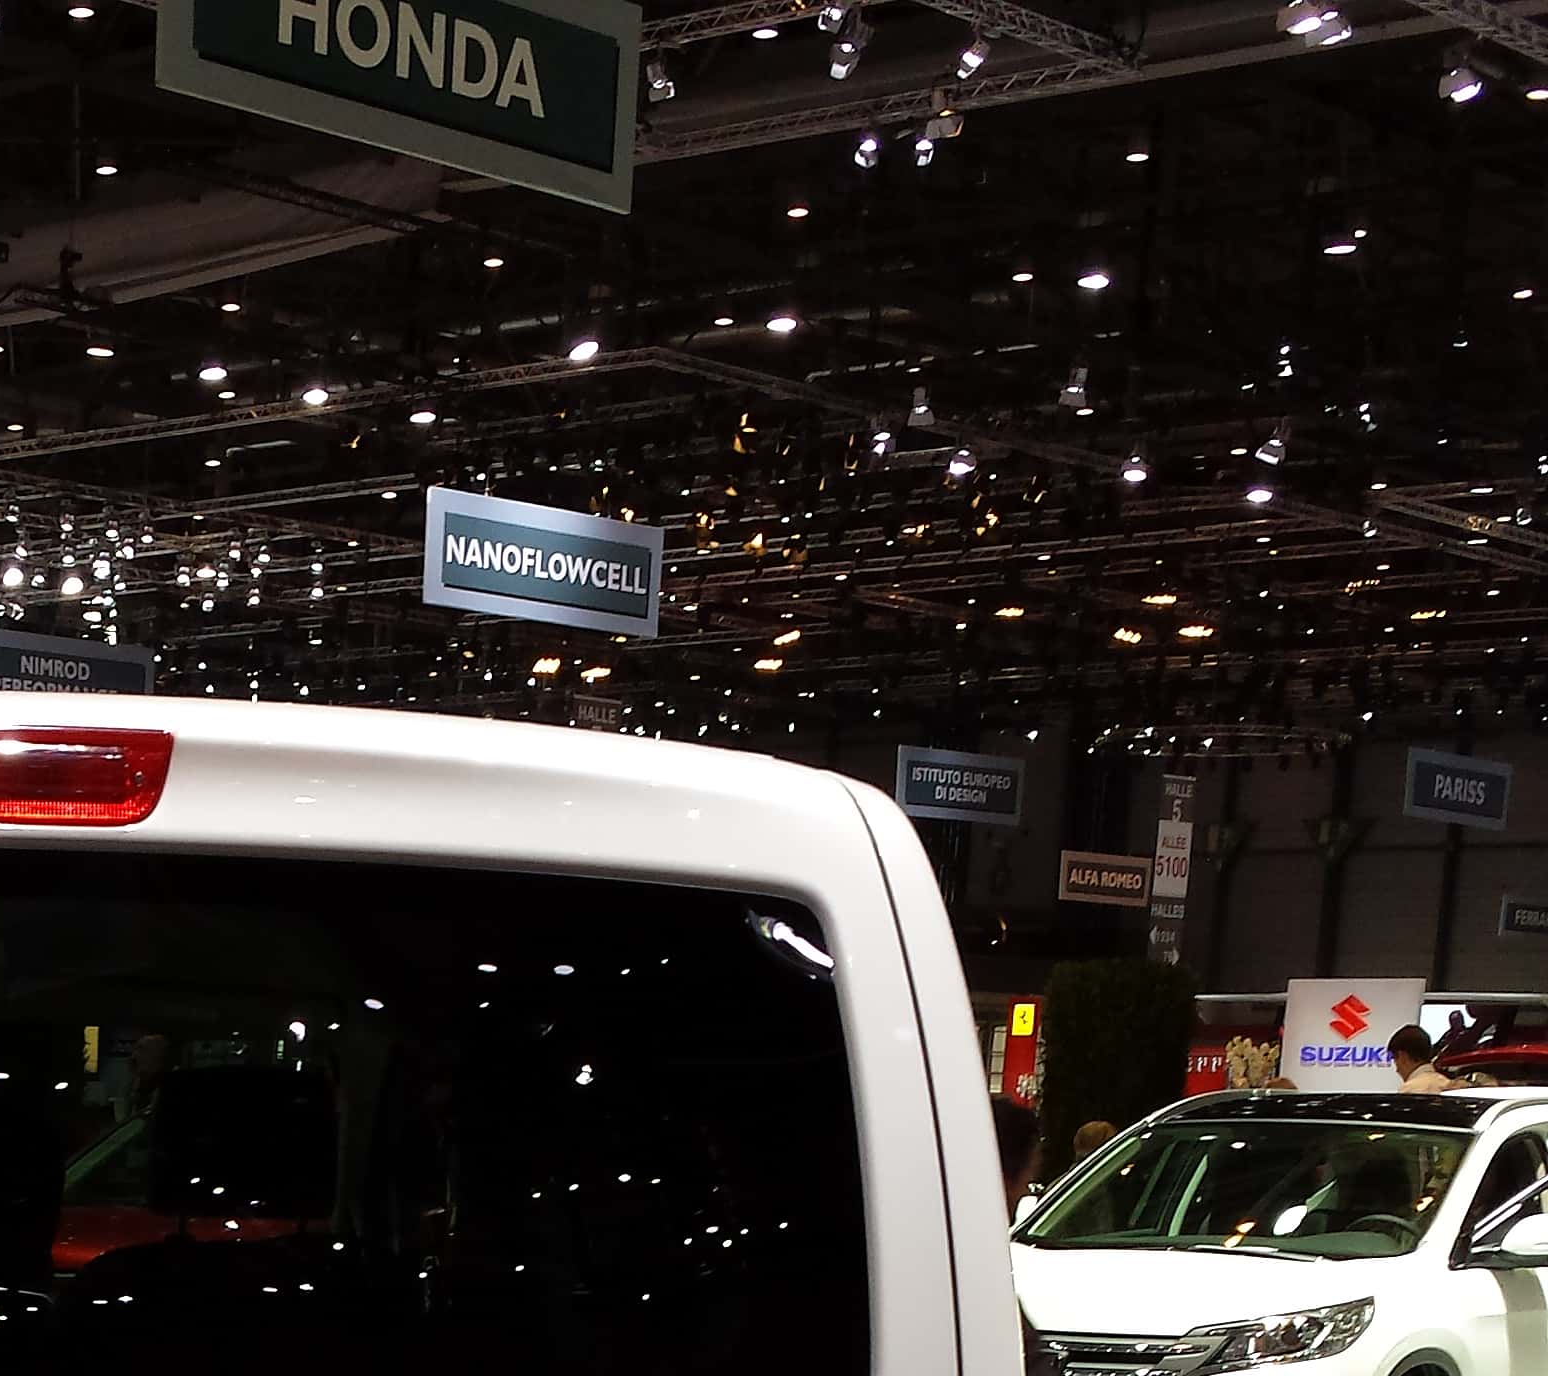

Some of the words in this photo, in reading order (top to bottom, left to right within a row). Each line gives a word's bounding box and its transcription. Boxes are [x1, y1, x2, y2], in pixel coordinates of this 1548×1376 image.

[276, 0, 546, 119] HONDA
[445, 534, 647, 596] NANOFLOWCELL
[20, 656, 91, 682] NIMROD
[912, 766, 961, 786] ISTITUTO
[962, 771, 1012, 791] EUROPEO
[1433, 773, 1485, 805] PARISS
[934, 785, 948, 800] DI
[948, 788, 987, 804] DESIGN
[1172, 799, 1183, 822] 5
[1069, 867, 1099, 887] ALFA
[1100, 871, 1143, 890] ROMEO
[1155, 855, 1188, 879] 5100
